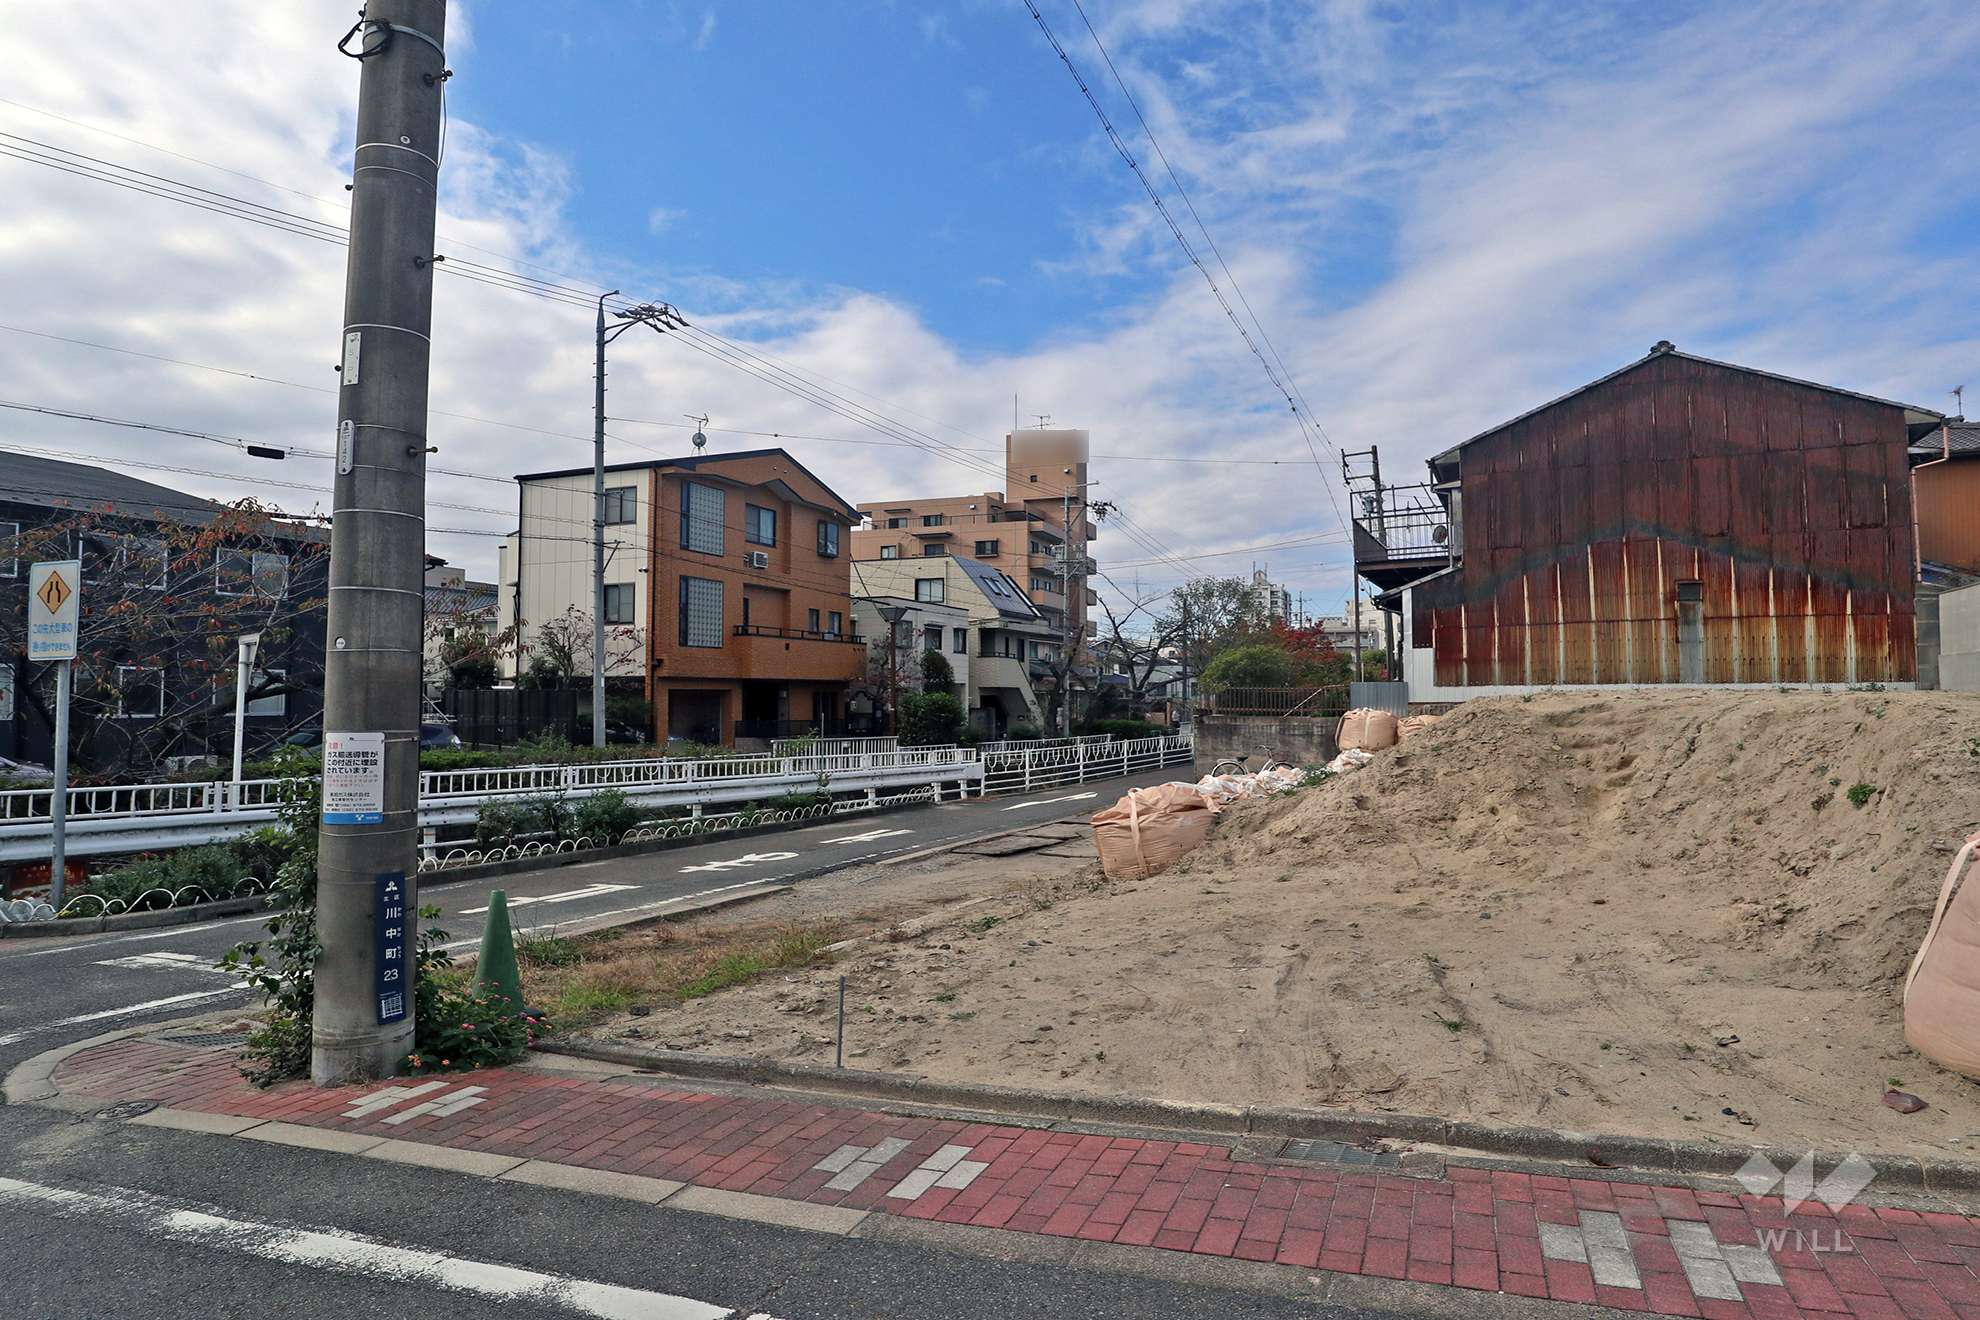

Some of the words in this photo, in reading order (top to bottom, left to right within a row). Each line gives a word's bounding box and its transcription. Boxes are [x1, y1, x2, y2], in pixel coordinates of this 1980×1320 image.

[385, 907, 397, 959] 川中町
[383, 968, 399, 981] 23
